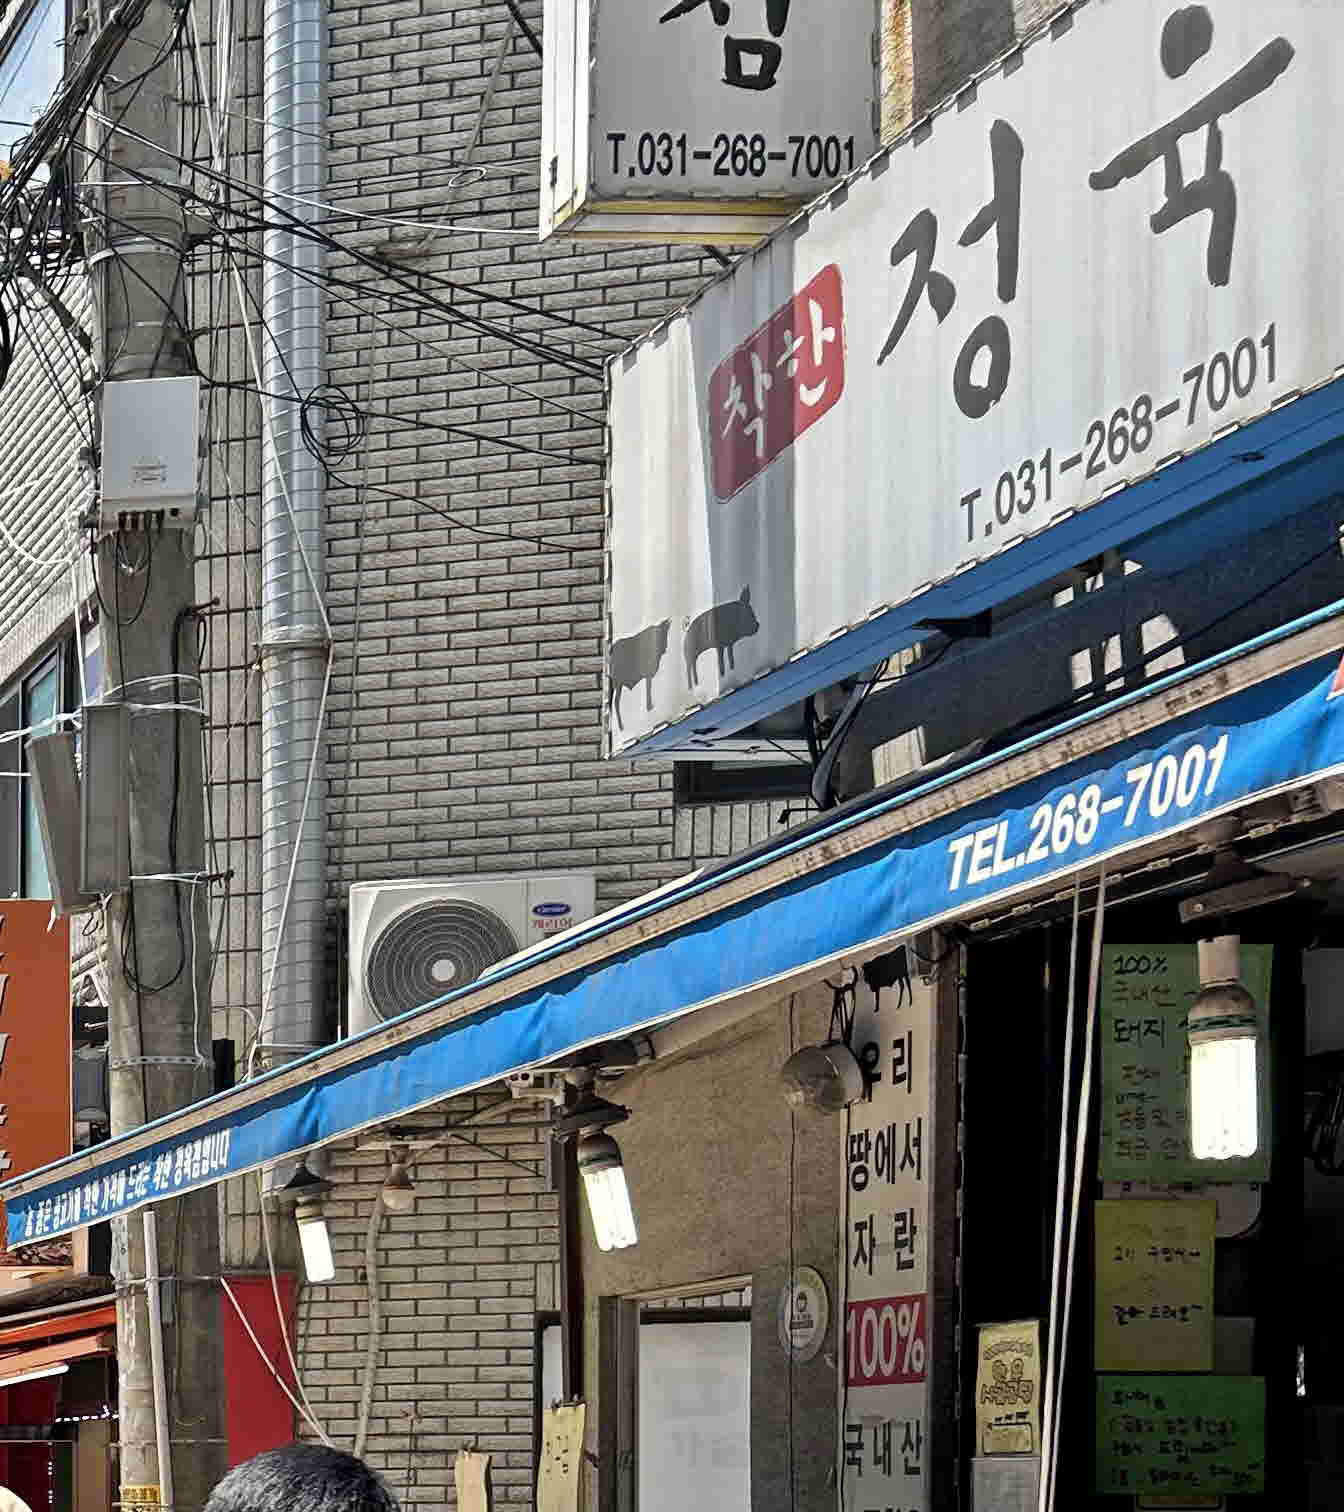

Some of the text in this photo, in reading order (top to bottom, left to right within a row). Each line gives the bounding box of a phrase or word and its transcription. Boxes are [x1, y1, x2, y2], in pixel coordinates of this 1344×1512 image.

[606, 132, 857, 180] T.031-268-7001
[960, 323, 1278, 543] T.031-268-7001
[947, 732, 1231, 892] TEL.268-7001
[848, 1117, 923, 1192] 땅에서
[852, 1207, 918, 1277] 자란
[847, 1302, 925, 1381] 100%
[844, 1418, 923, 1478] 국내산
